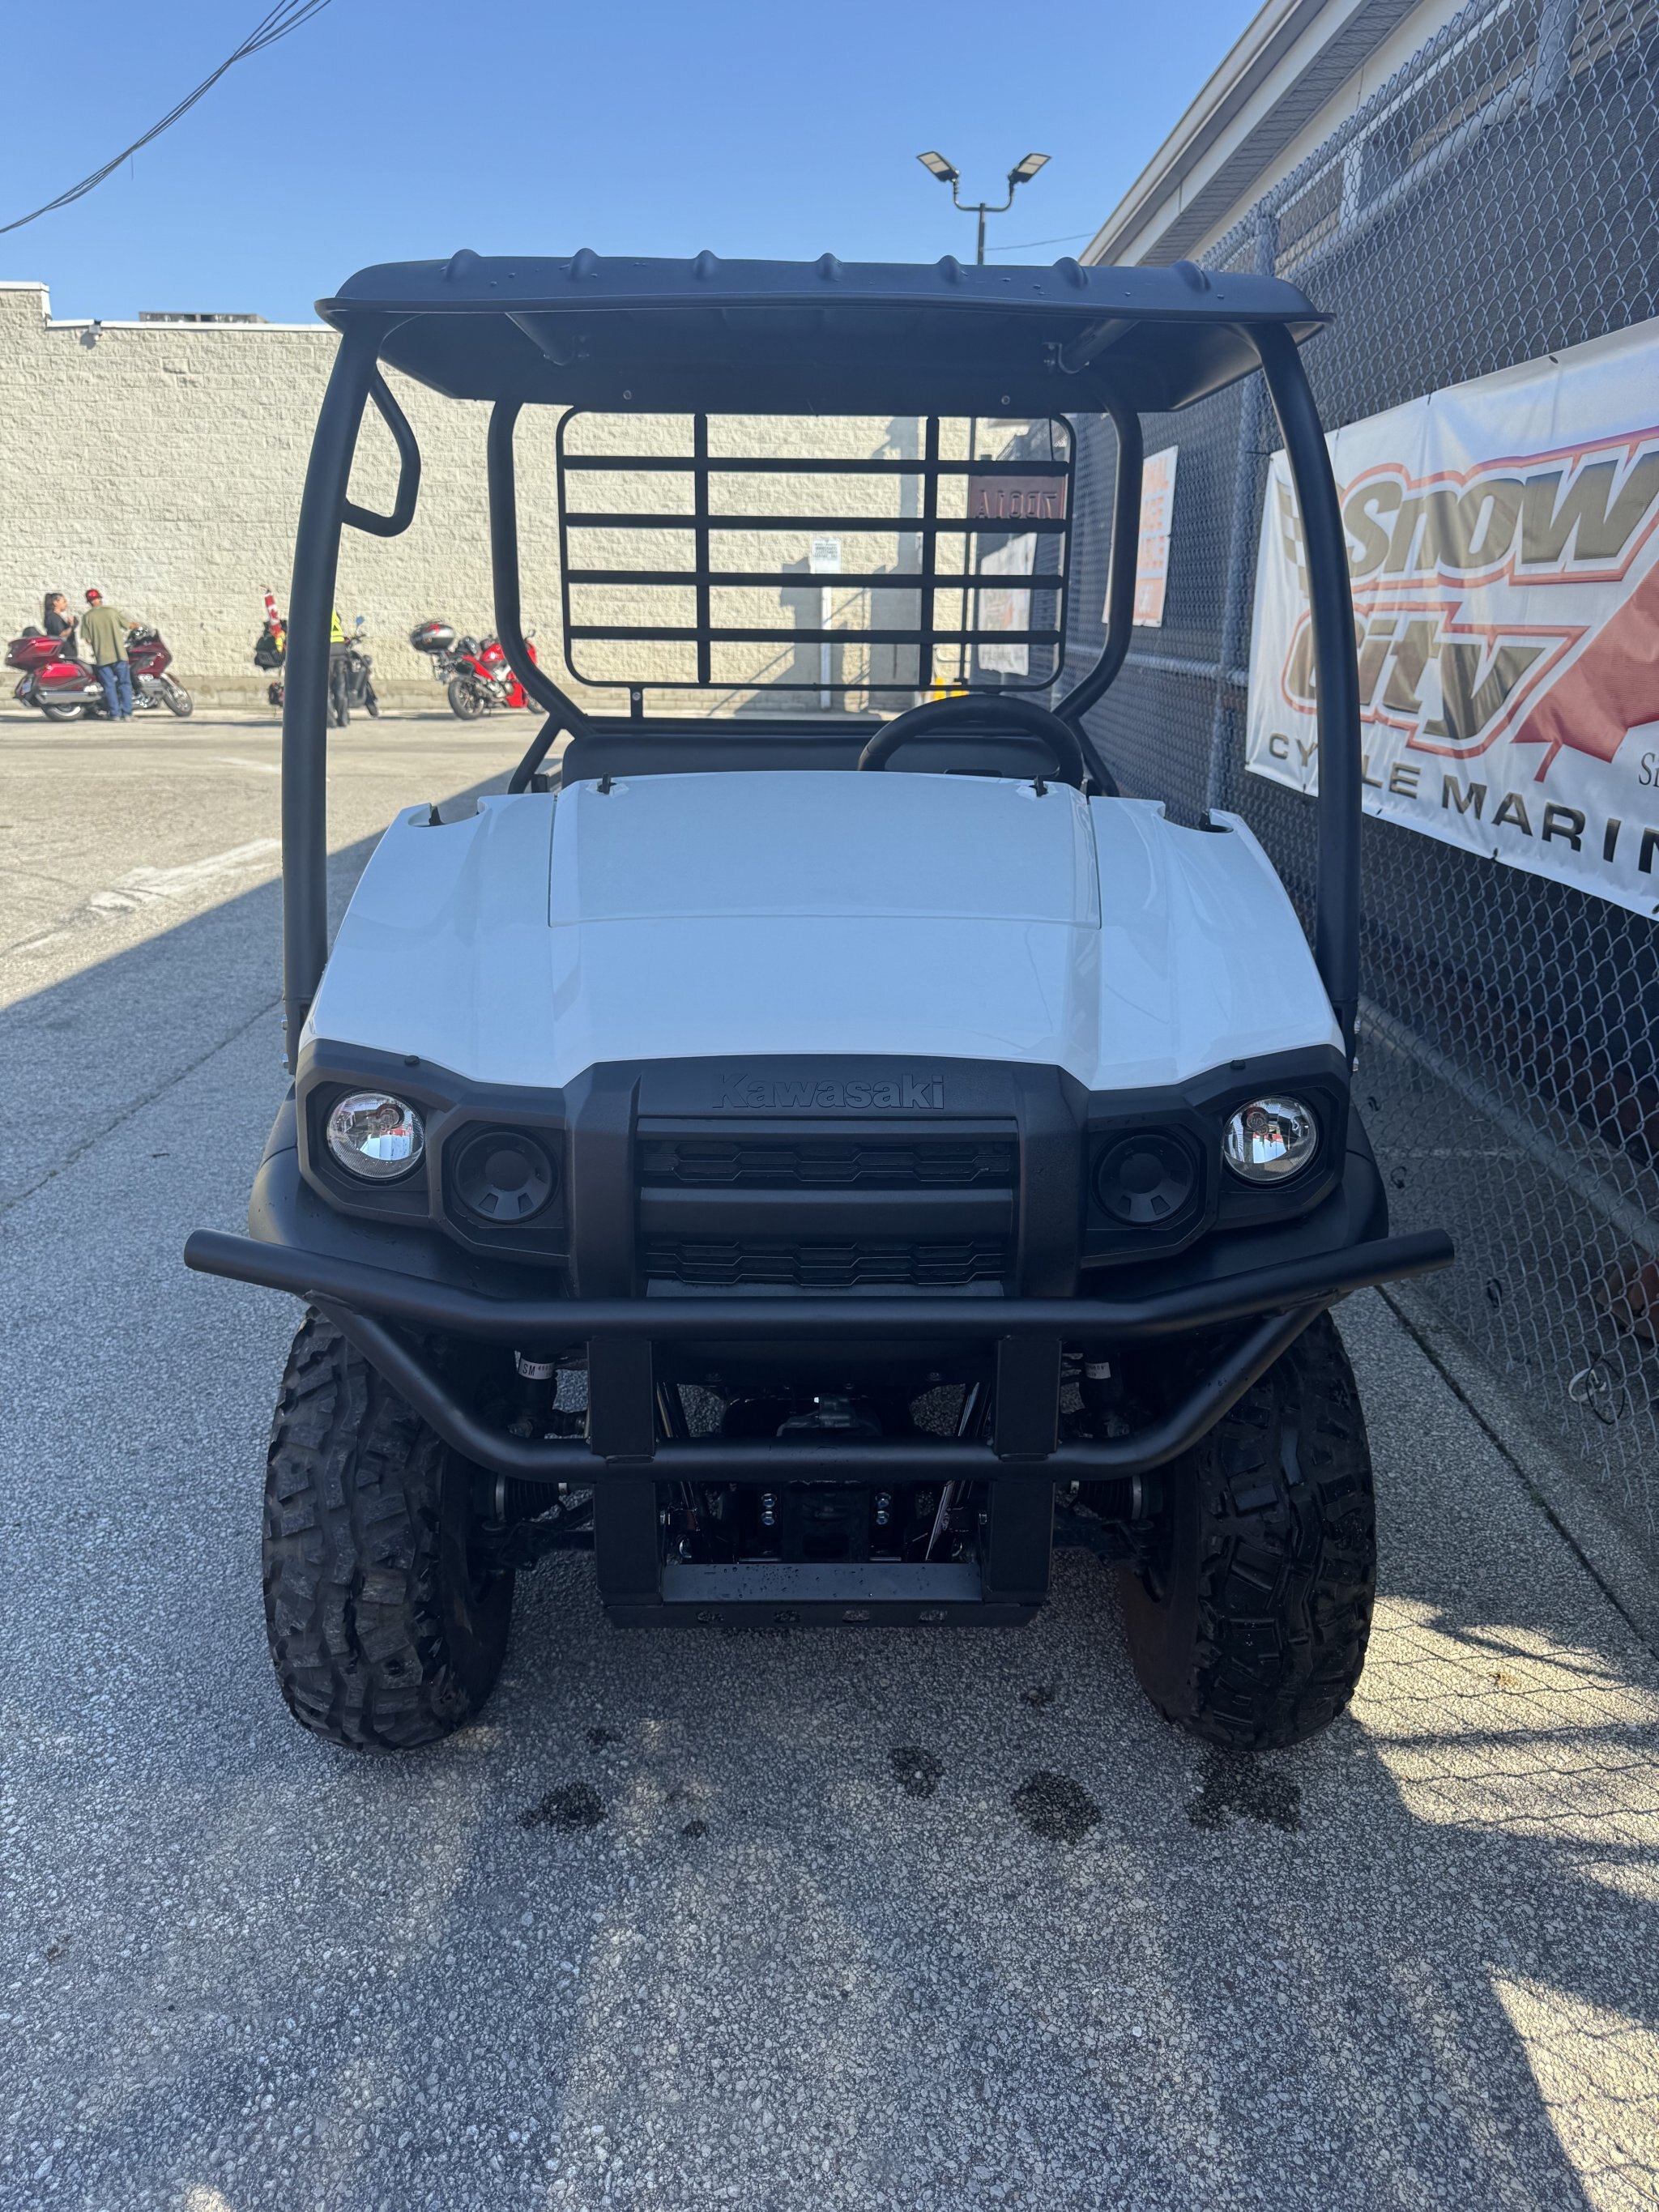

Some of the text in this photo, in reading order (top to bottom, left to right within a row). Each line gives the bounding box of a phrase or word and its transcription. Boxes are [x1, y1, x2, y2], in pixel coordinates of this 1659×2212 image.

[1269, 733, 1421, 799] CYLE
[713, 1074, 944, 1109] Kawasaki
[522, 1364, 535, 1376] SM
